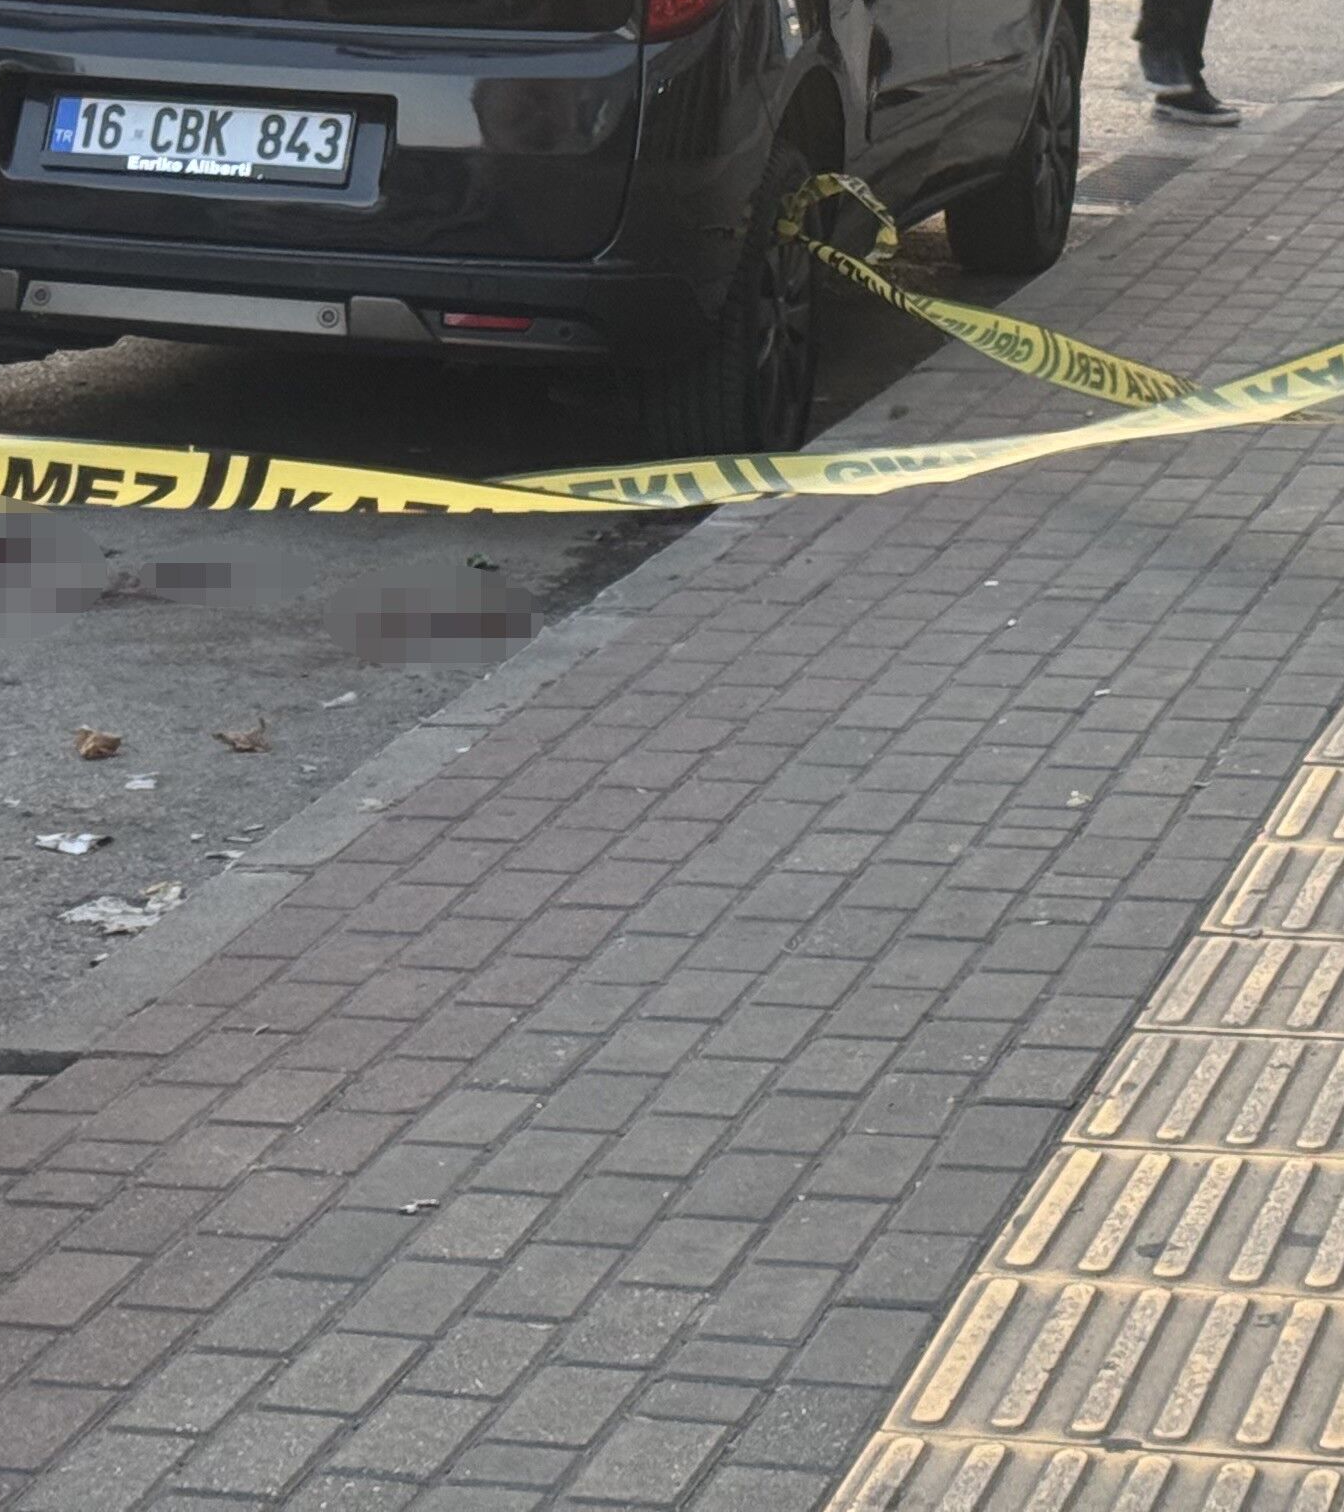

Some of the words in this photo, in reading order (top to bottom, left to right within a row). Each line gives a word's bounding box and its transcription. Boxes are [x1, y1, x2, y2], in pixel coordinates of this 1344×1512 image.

[81, 102, 125, 150] 16
[150, 106, 233, 157] CBK
[256, 114, 343, 164] 843
